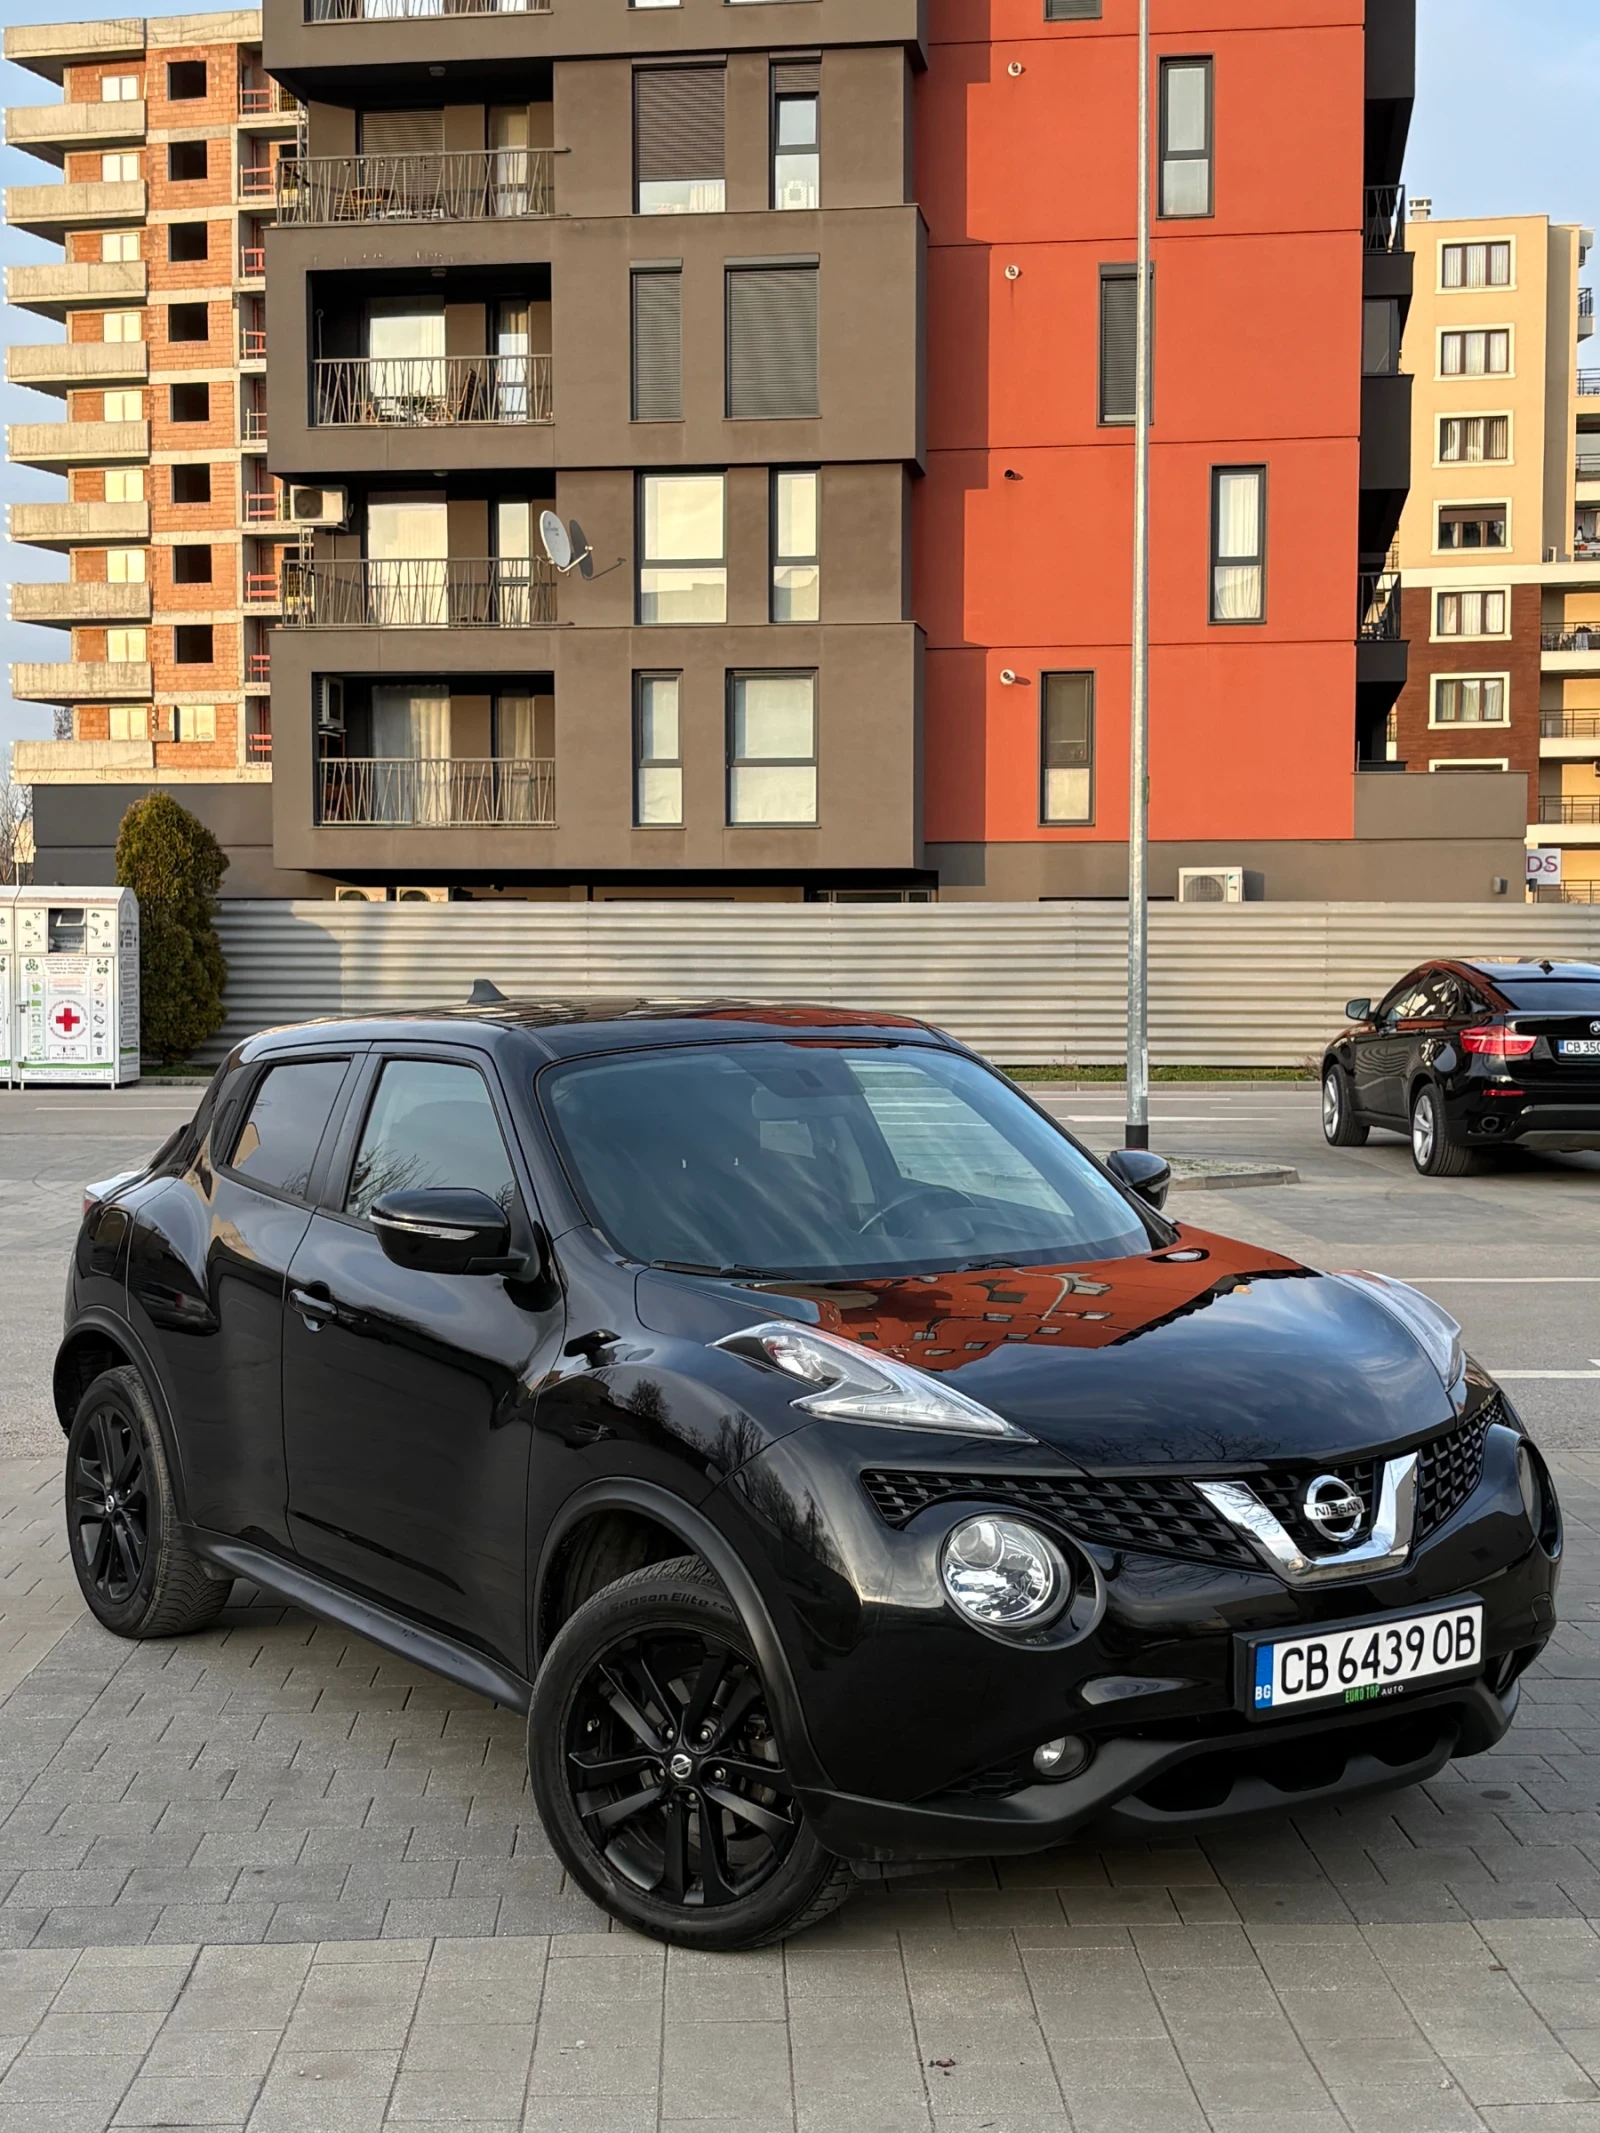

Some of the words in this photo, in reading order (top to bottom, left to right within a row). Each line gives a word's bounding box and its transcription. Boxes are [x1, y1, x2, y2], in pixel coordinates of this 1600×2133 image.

[1566, 1041, 1581, 1053] CB
[1315, 1500, 1361, 1516] NISSAN
[610, 1594, 669, 1614] Season
[671, 1592, 709, 1608] Elite
[1281, 1643, 1328, 1695] CB
[1338, 1625, 1425, 1684] 6439
[1432, 1615, 1476, 1665] OB
[1254, 1684, 1271, 1700] BG
[1345, 1687, 1364, 1703] EURO
[1366, 1684, 1380, 1699] TOP
[1381, 1685, 1404, 1697] AUTO
